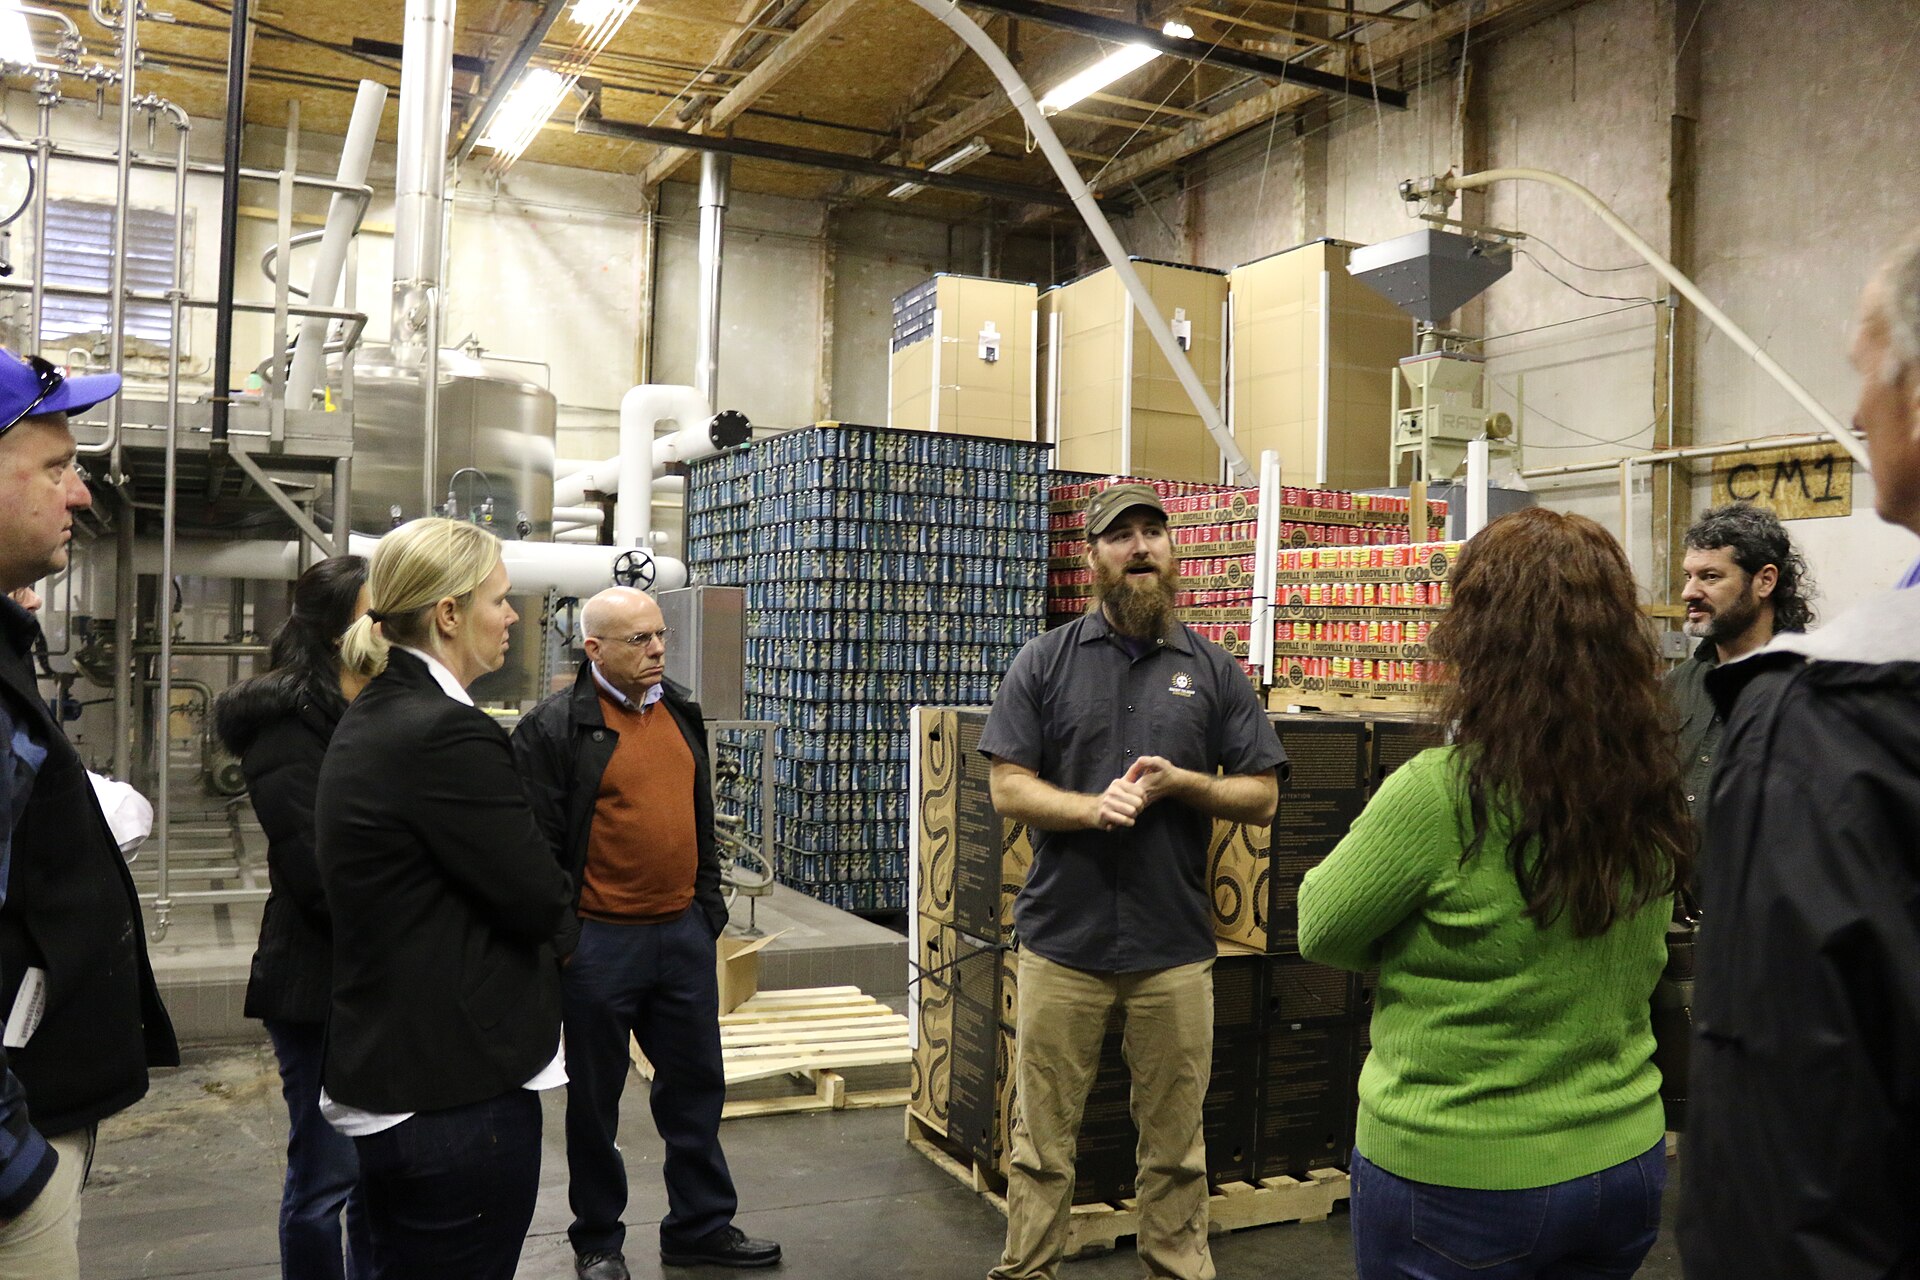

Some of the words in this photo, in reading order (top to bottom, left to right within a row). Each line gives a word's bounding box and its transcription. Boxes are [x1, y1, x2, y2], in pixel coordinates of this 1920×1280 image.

[1181, 513, 1204, 521] LOUISVILLE
[1314, 510, 1347, 520] LOUISVILLE
[1349, 512, 1356, 520] KY
[1363, 511, 1391, 520] LOUISVILLE
[1193, 543, 1217, 552] LOUISVILLE
[1229, 540, 1255, 550] LOUISVILLE
[1302, 571, 1310, 579] KY
[1314, 570, 1343, 579] LOUISVILLE
[1345, 570, 1354, 578] KY
[1356, 569, 1390, 578] LOUISVILLE
[1392, 568, 1400, 577] KY
[1179, 576, 1201, 585] OUISVILLE
[1189, 609, 1213, 617] LOUISVILLE
[1224, 608, 1250, 617] LOUISVILLE
[1328, 606, 1361, 616] LOUISVILLE
[1376, 607, 1409, 616] LOUISVILLE
[1301, 642, 1309, 650] KY
[1313, 643, 1343, 652] LOUISVILLE
[1345, 644, 1354, 652] KY
[1355, 645, 1388, 653] LOUISVILLE
[1390, 645, 1399, 653] KY
[1329, 679, 1360, 689] LOUISVILLE
[1361, 681, 1370, 689] KY
[1373, 682, 1408, 692] LOUISVILLE
